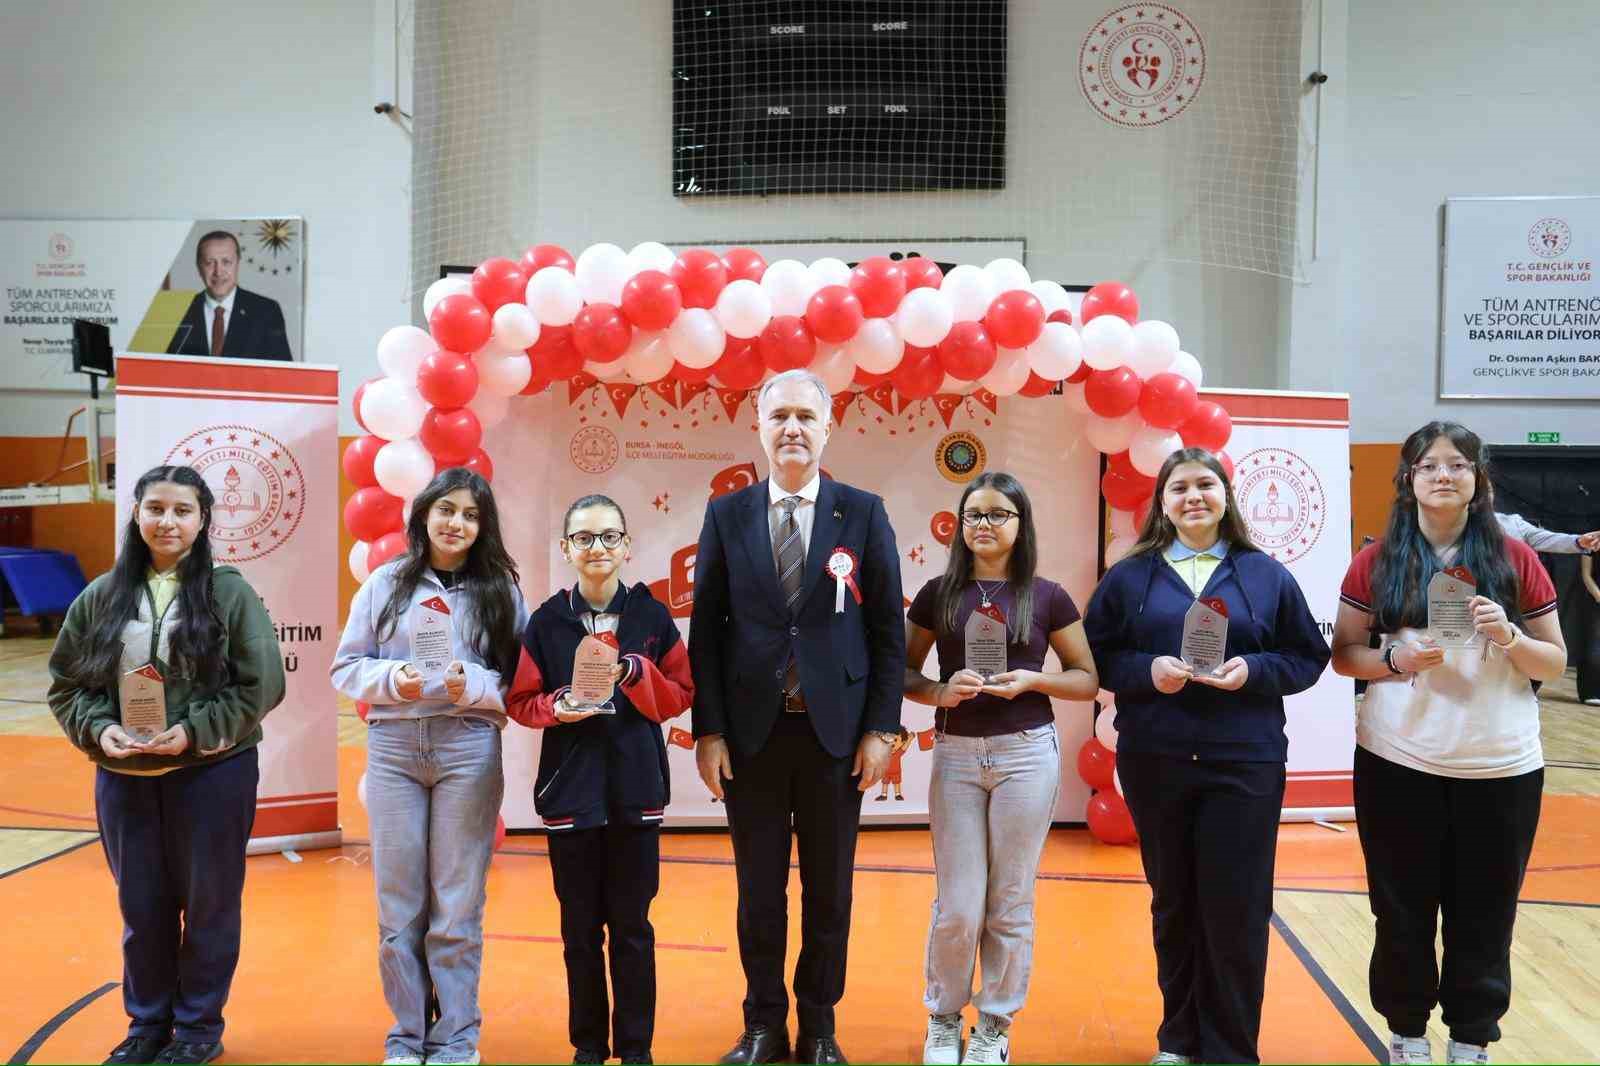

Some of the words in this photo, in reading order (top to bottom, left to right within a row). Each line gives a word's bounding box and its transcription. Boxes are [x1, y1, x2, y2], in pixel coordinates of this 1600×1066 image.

[770, 25, 805, 34] SCORE
[872, 21, 907, 31] SCORE
[767, 106, 791, 115] FOUL
[827, 105, 847, 114] SET
[884, 104, 909, 113] FOUL
[1528, 262, 1574, 272] GENÇLİK
[1577, 262, 1591, 270] VE
[1506, 273, 1533, 282] SPOR
[1535, 272, 1591, 281] BAKANLIĞI
[7, 286, 33, 299] TÜM
[35, 286, 98, 300] ANTRENÖR
[102, 288, 117, 300] VE
[9, 301, 113, 313] SPORCULARIMIZA
[1482, 296, 1519, 312] TÜM
[4, 316, 60, 327] BAŞARILAR
[1464, 313, 1484, 326] VE
[1469, 329, 1544, 342] BAŞARILAR
[1489, 354, 1504, 363] Dr.
[1506, 354, 1544, 363] Osman
[1547, 354, 1576, 365] Aşkın
[1539, 367, 1570, 377] SPOR
[625, 441, 651, 449] BURSA
[272, 622, 322, 642] İTİM
